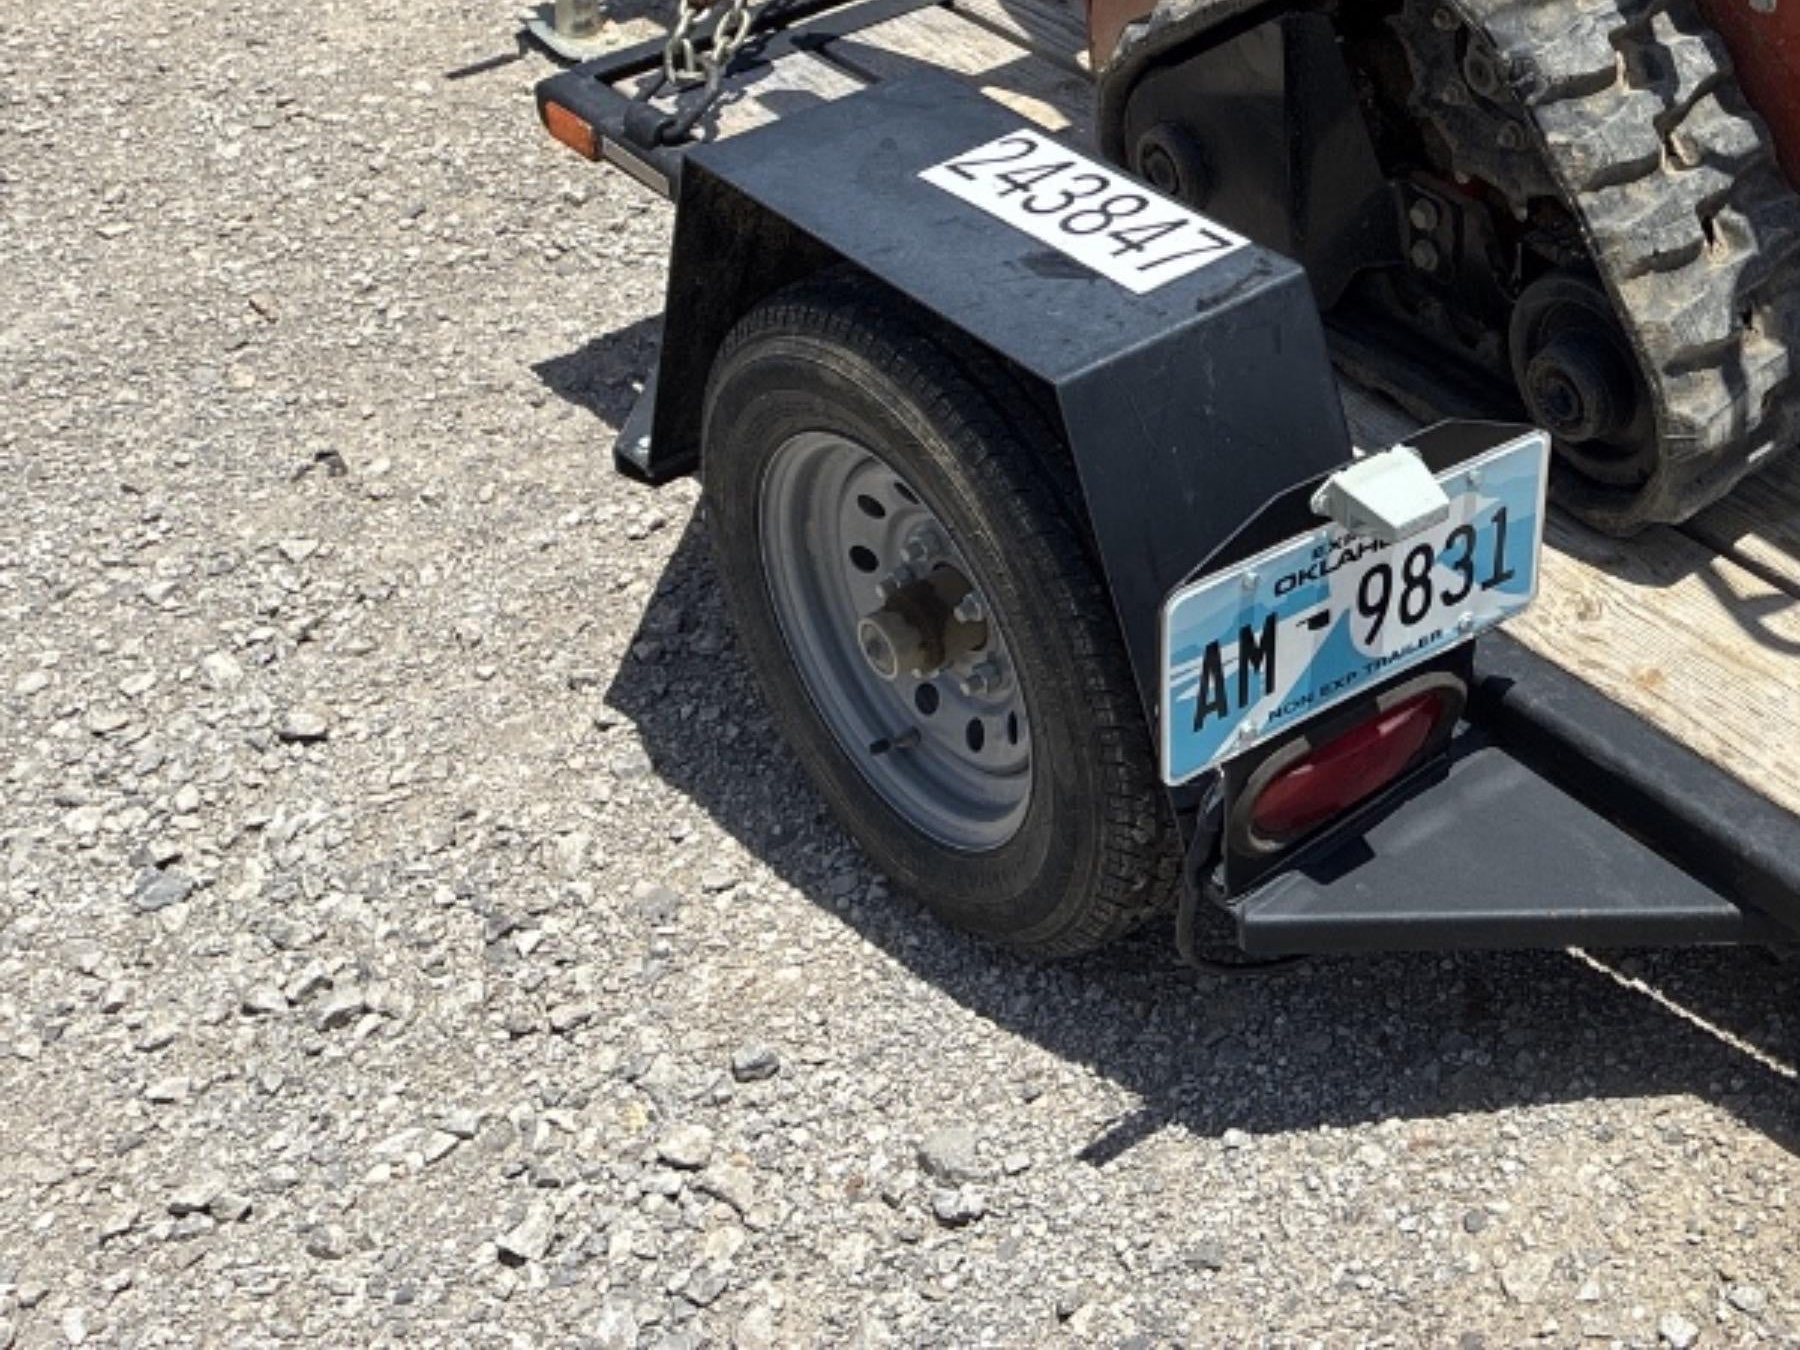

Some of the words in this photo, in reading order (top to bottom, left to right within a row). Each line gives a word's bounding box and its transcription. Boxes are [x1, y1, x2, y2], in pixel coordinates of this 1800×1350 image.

[944, 137, 1234, 272] 243847
[1193, 611, 1277, 733] AM
[1356, 506, 1515, 646] 9831
[1273, 538, 1393, 598] OKLAH
